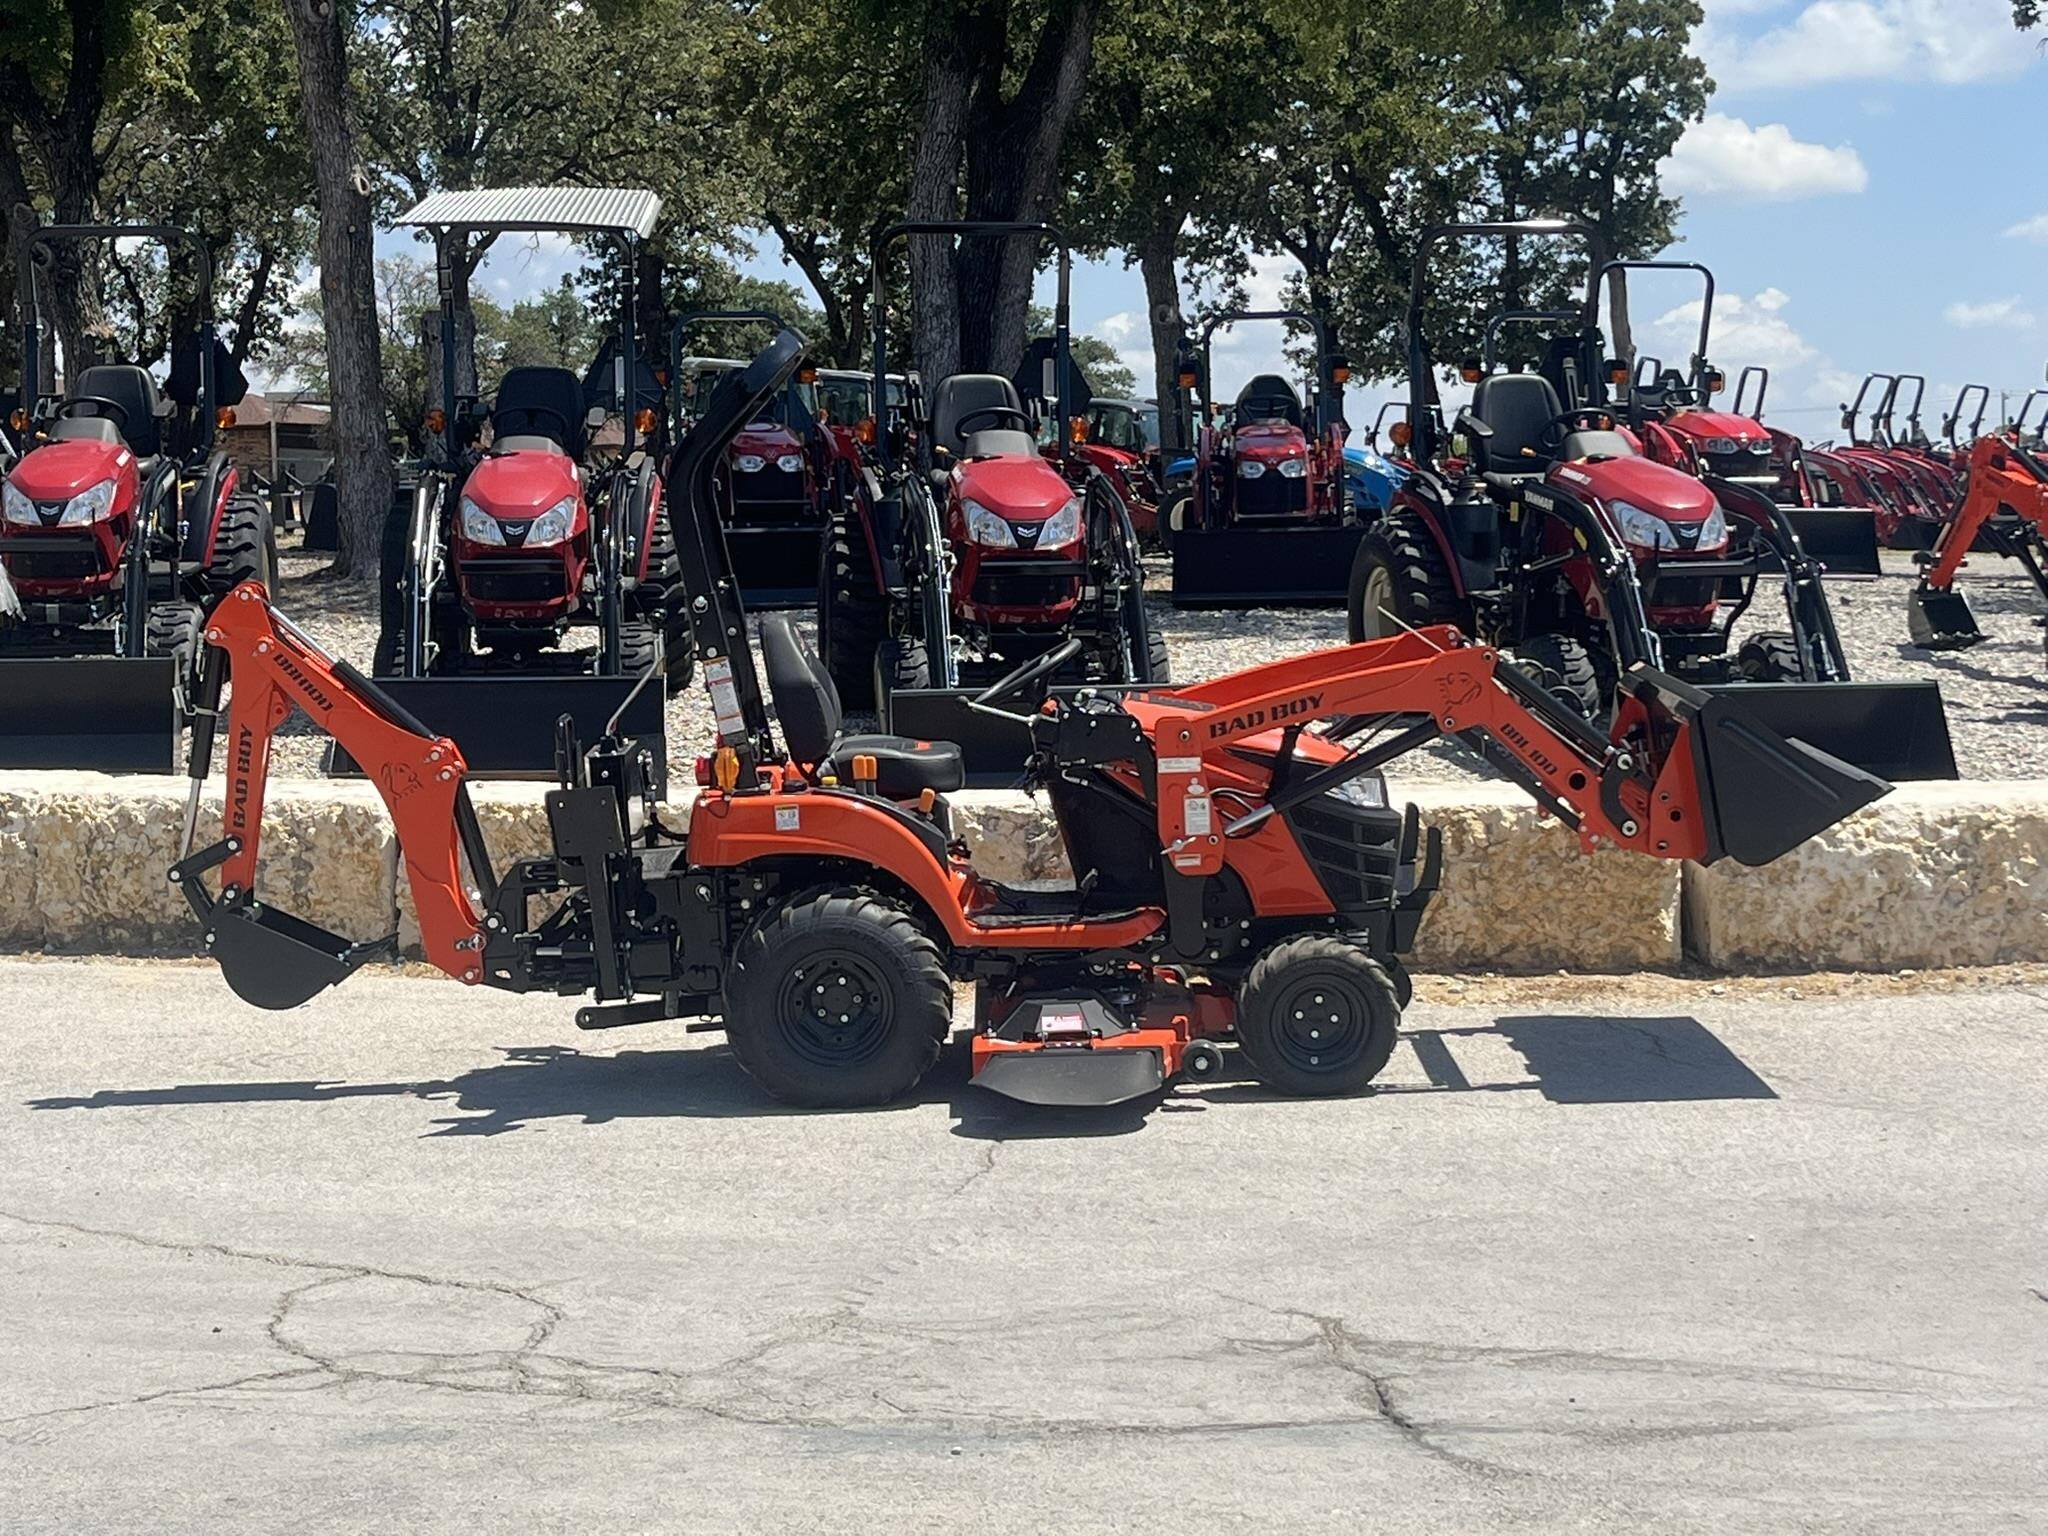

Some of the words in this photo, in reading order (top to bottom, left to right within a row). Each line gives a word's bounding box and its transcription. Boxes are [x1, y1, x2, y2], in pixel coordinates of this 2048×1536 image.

[1209, 711, 1264, 738] BAD
[1271, 692, 1324, 721] BOY
[237, 722, 252, 773] BOY
[1528, 750, 1558, 775] 100
[233, 778, 248, 829] BAD
